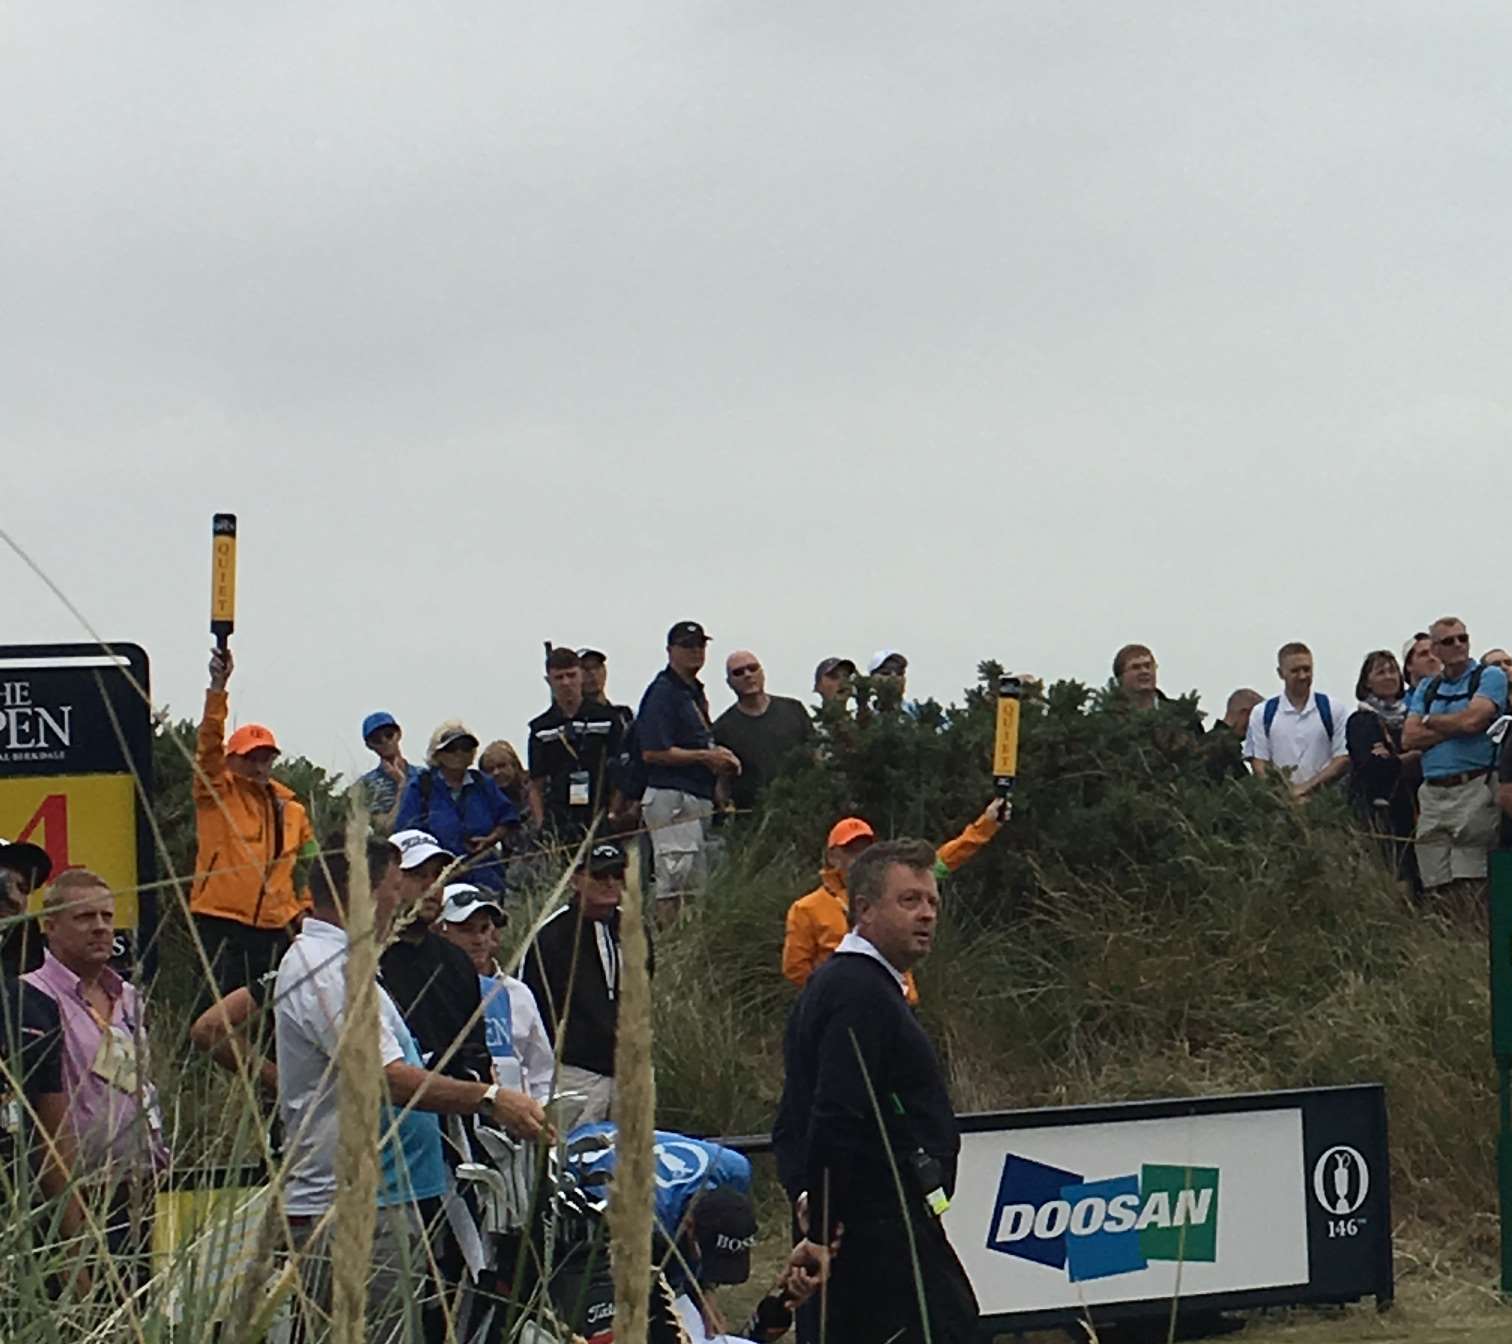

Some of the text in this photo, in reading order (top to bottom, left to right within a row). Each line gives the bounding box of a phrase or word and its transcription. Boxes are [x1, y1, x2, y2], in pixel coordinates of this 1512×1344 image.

[217, 542, 230, 612] QUIET
[0, 682, 32, 706] HE
[1001, 704, 1015, 767] QUIET
[484, 1017, 512, 1047] EN
[995, 1188, 1213, 1243] DOOSAN
